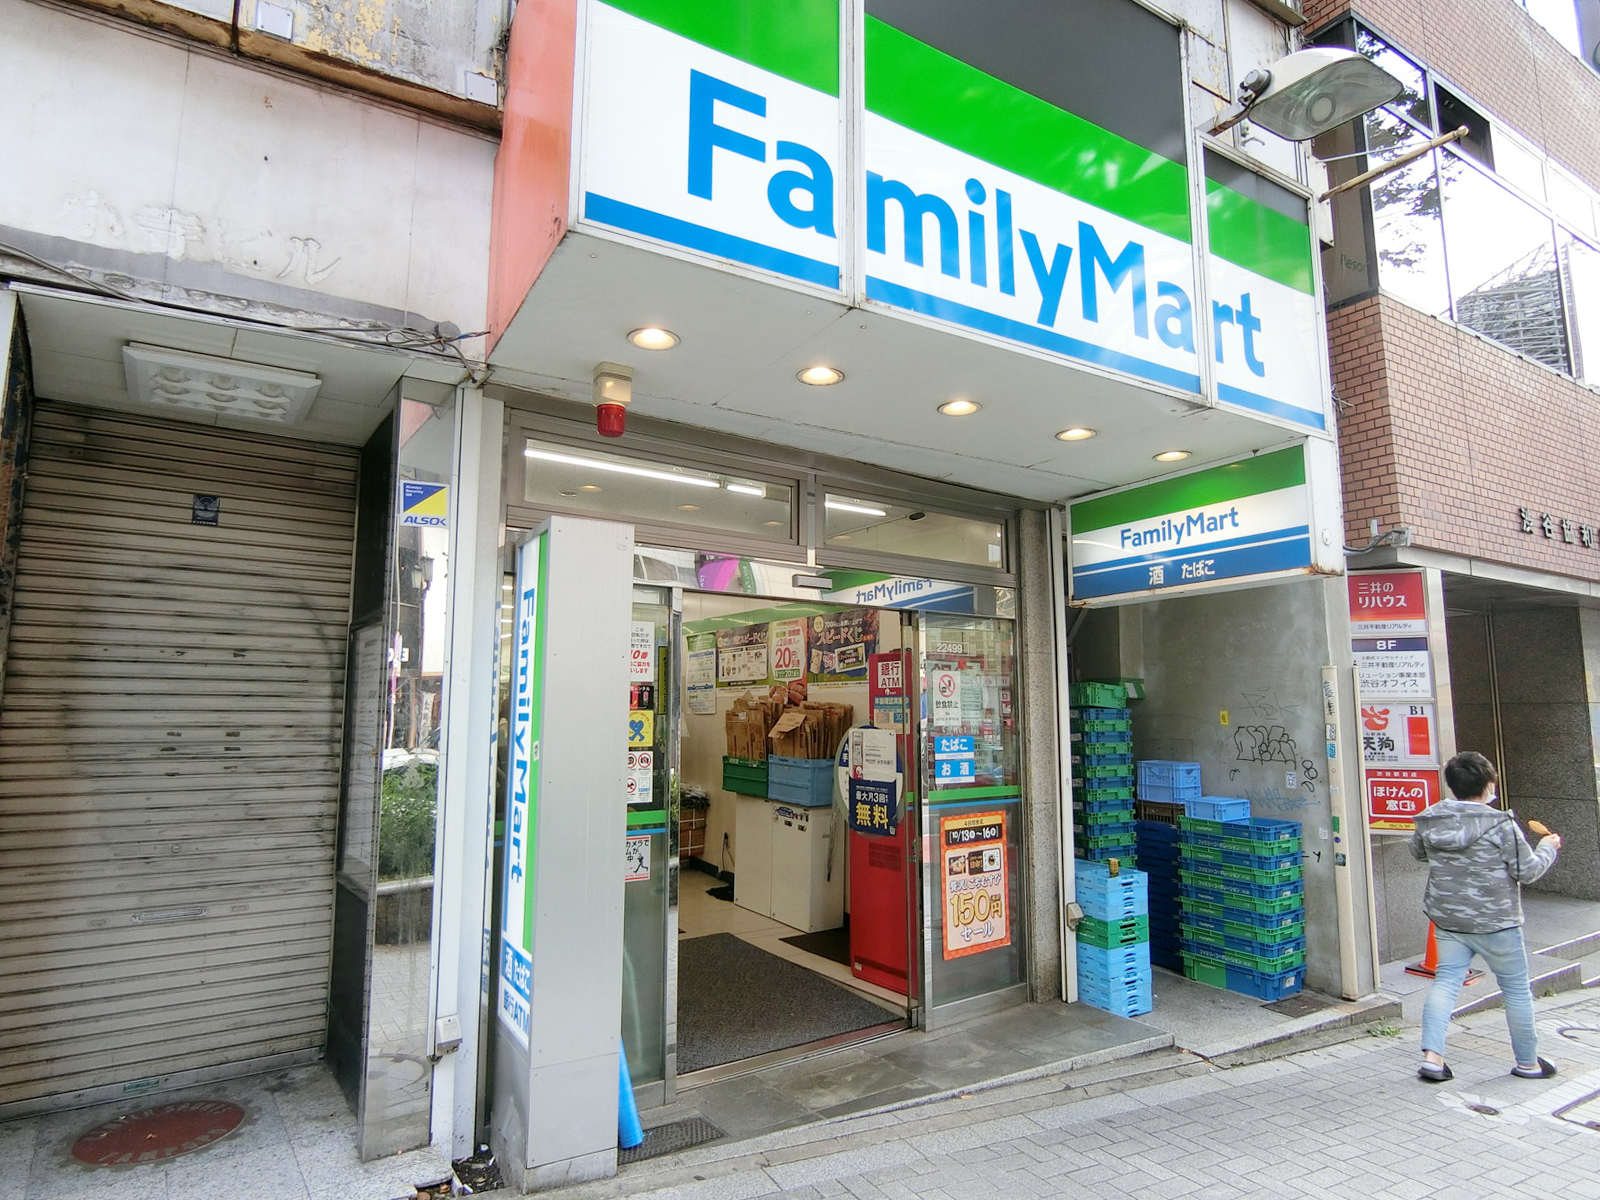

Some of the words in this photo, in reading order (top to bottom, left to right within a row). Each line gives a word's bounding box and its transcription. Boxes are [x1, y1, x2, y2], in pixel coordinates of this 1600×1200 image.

[688, 69, 1265, 379] FamilyMart
[404, 515, 447, 526] ALSOK
[1120, 506, 1239, 550] FamilyMart
[1148, 565, 1165, 585] 酒
[1181, 559, 1216, 579] たばこ
[1358, 582, 1395, 595] 三井の
[1358, 595, 1408, 608] リハウス
[816, 627, 864, 646] スピードくじ
[936, 643, 963, 654] 22499
[1376, 640, 1397, 650] 8F
[880, 662, 900, 676] 銀行
[881, 677, 900, 688] ATM
[1360, 679, 1419, 688] 渋谷オフィス
[935, 700, 959, 709] 飲食禁止
[1409, 705, 1425, 716] B1
[511, 587, 536, 884] FamilyMart
[941, 738, 968, 752] たばこ
[1363, 736, 1395, 751] 天狗
[941, 762, 951, 776] お
[960, 762, 970, 775] 酒
[1373, 786, 1423, 798] ほけんの
[1385, 799, 1410, 811] 窓口
[856, 801, 889, 830] 無料
[961, 921, 994, 942] セール
